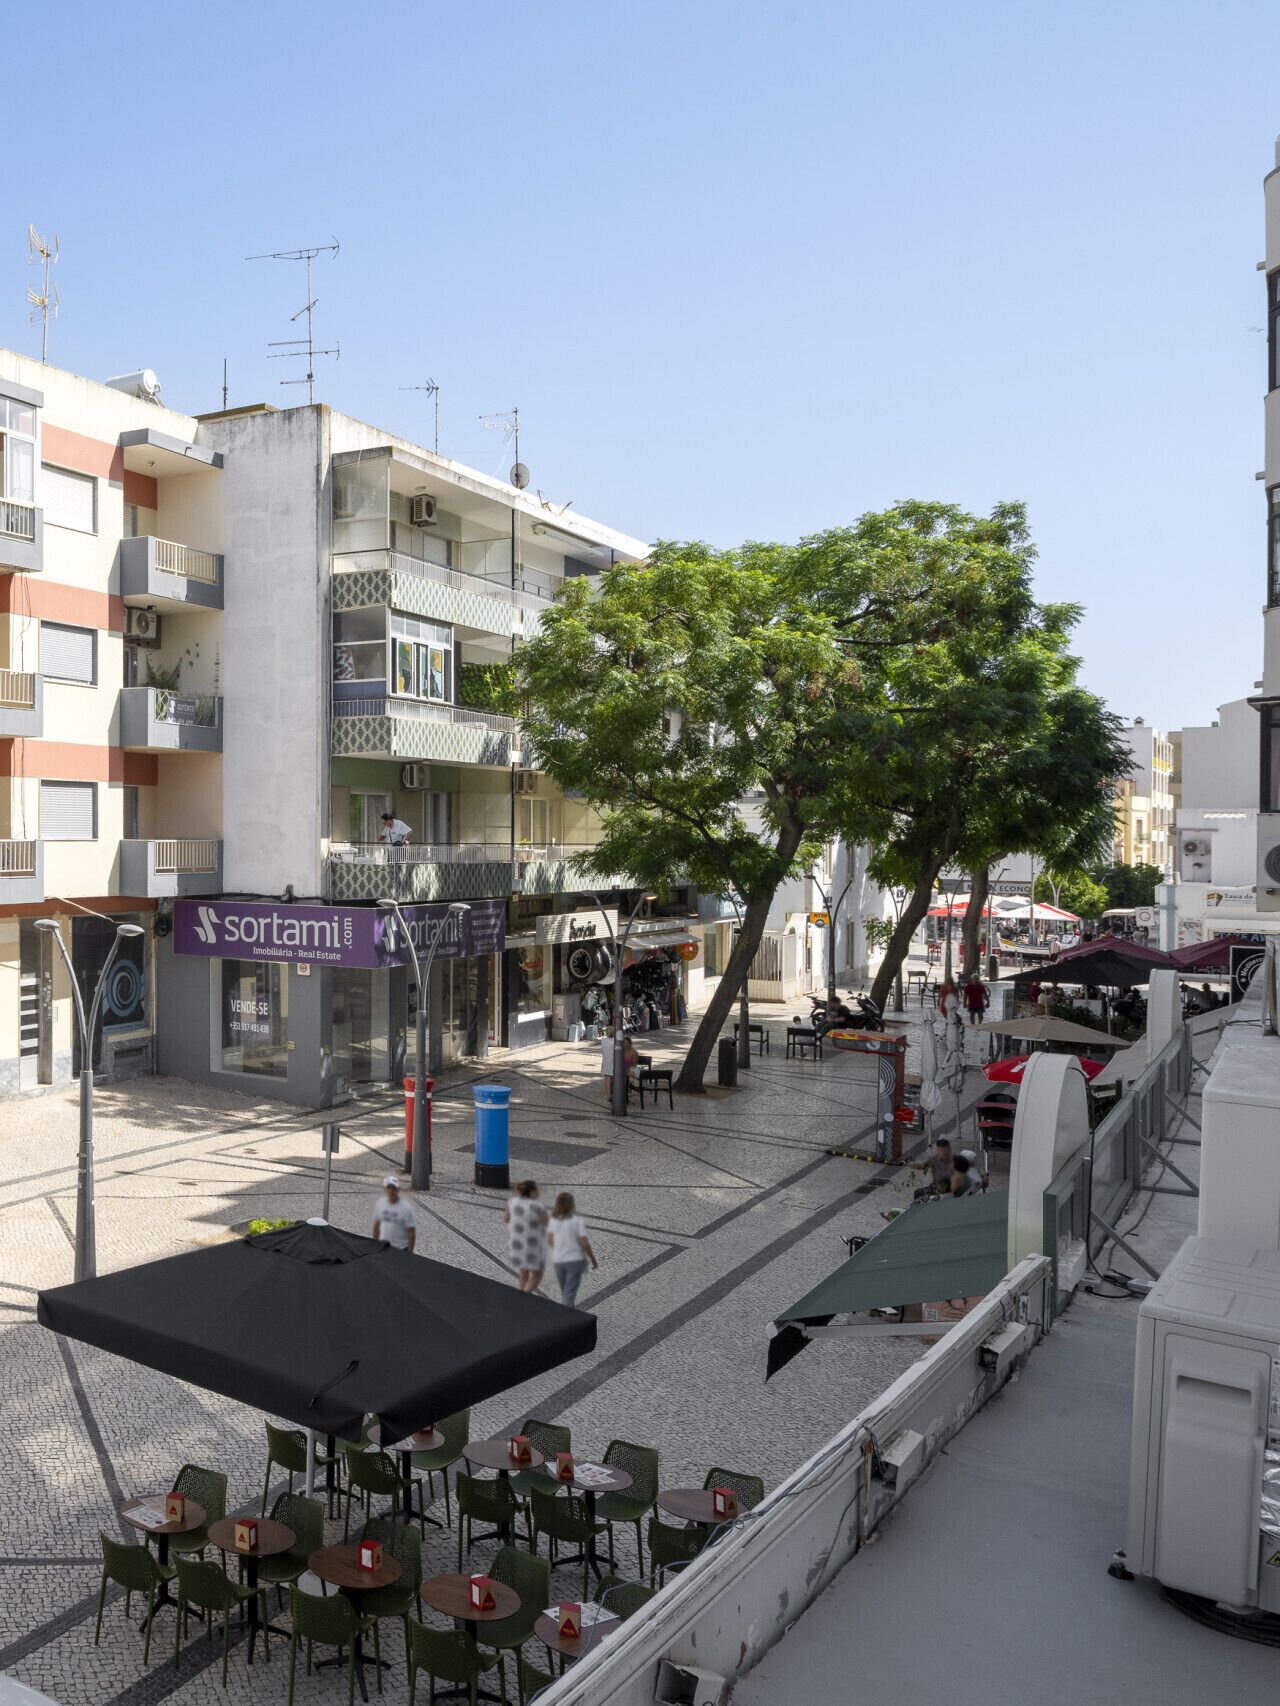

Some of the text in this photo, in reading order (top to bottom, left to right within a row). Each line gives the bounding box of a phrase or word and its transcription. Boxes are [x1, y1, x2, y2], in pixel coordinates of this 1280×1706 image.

[224, 912, 341, 948] sortami
[343, 917, 353, 949] .com
[253, 946, 293, 958] Imobiliária
[298, 949, 315, 959] Real
[316, 950, 341, 961] Estate
[230, 999, 268, 1016] VENDE-SE
